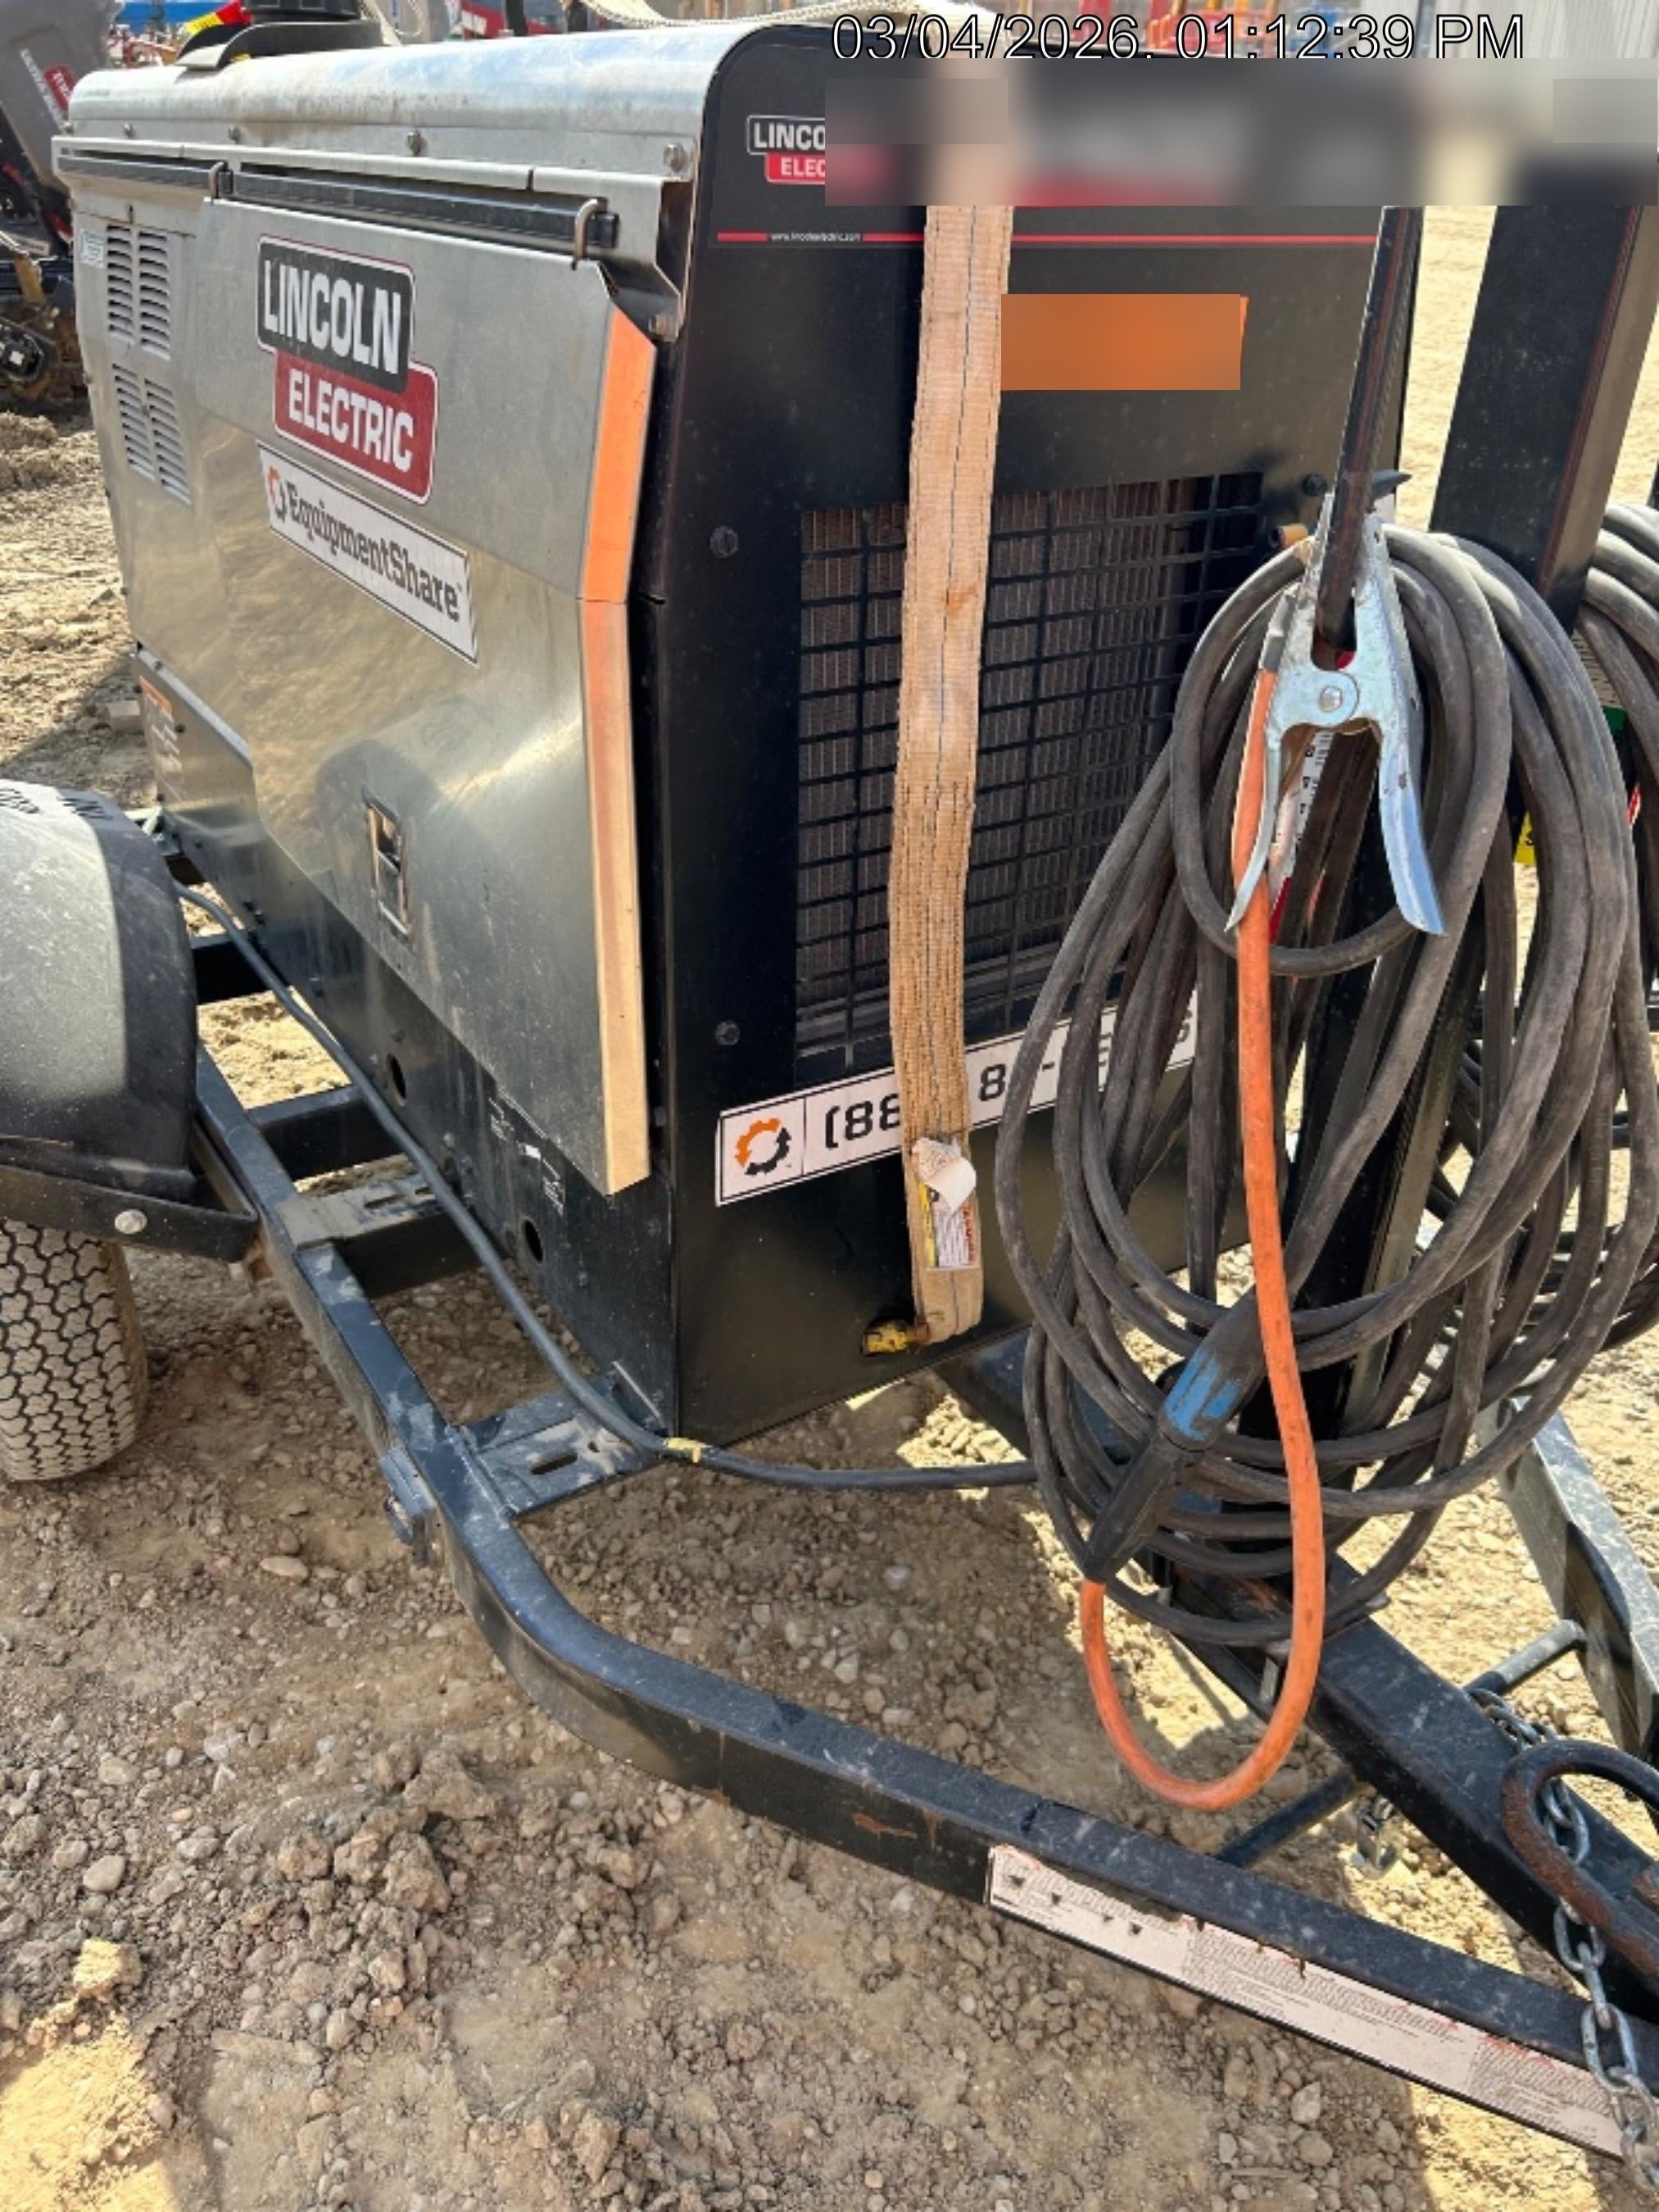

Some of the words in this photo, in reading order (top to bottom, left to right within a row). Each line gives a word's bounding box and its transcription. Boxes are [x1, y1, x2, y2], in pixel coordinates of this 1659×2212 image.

[753, 123, 826, 151] LINCO
[780, 157, 826, 178] ELEC
[264, 259, 401, 374] LINCOLN
[288, 367, 414, 473] ELECTRIC
[284, 480, 460, 623] EquipmentShare
